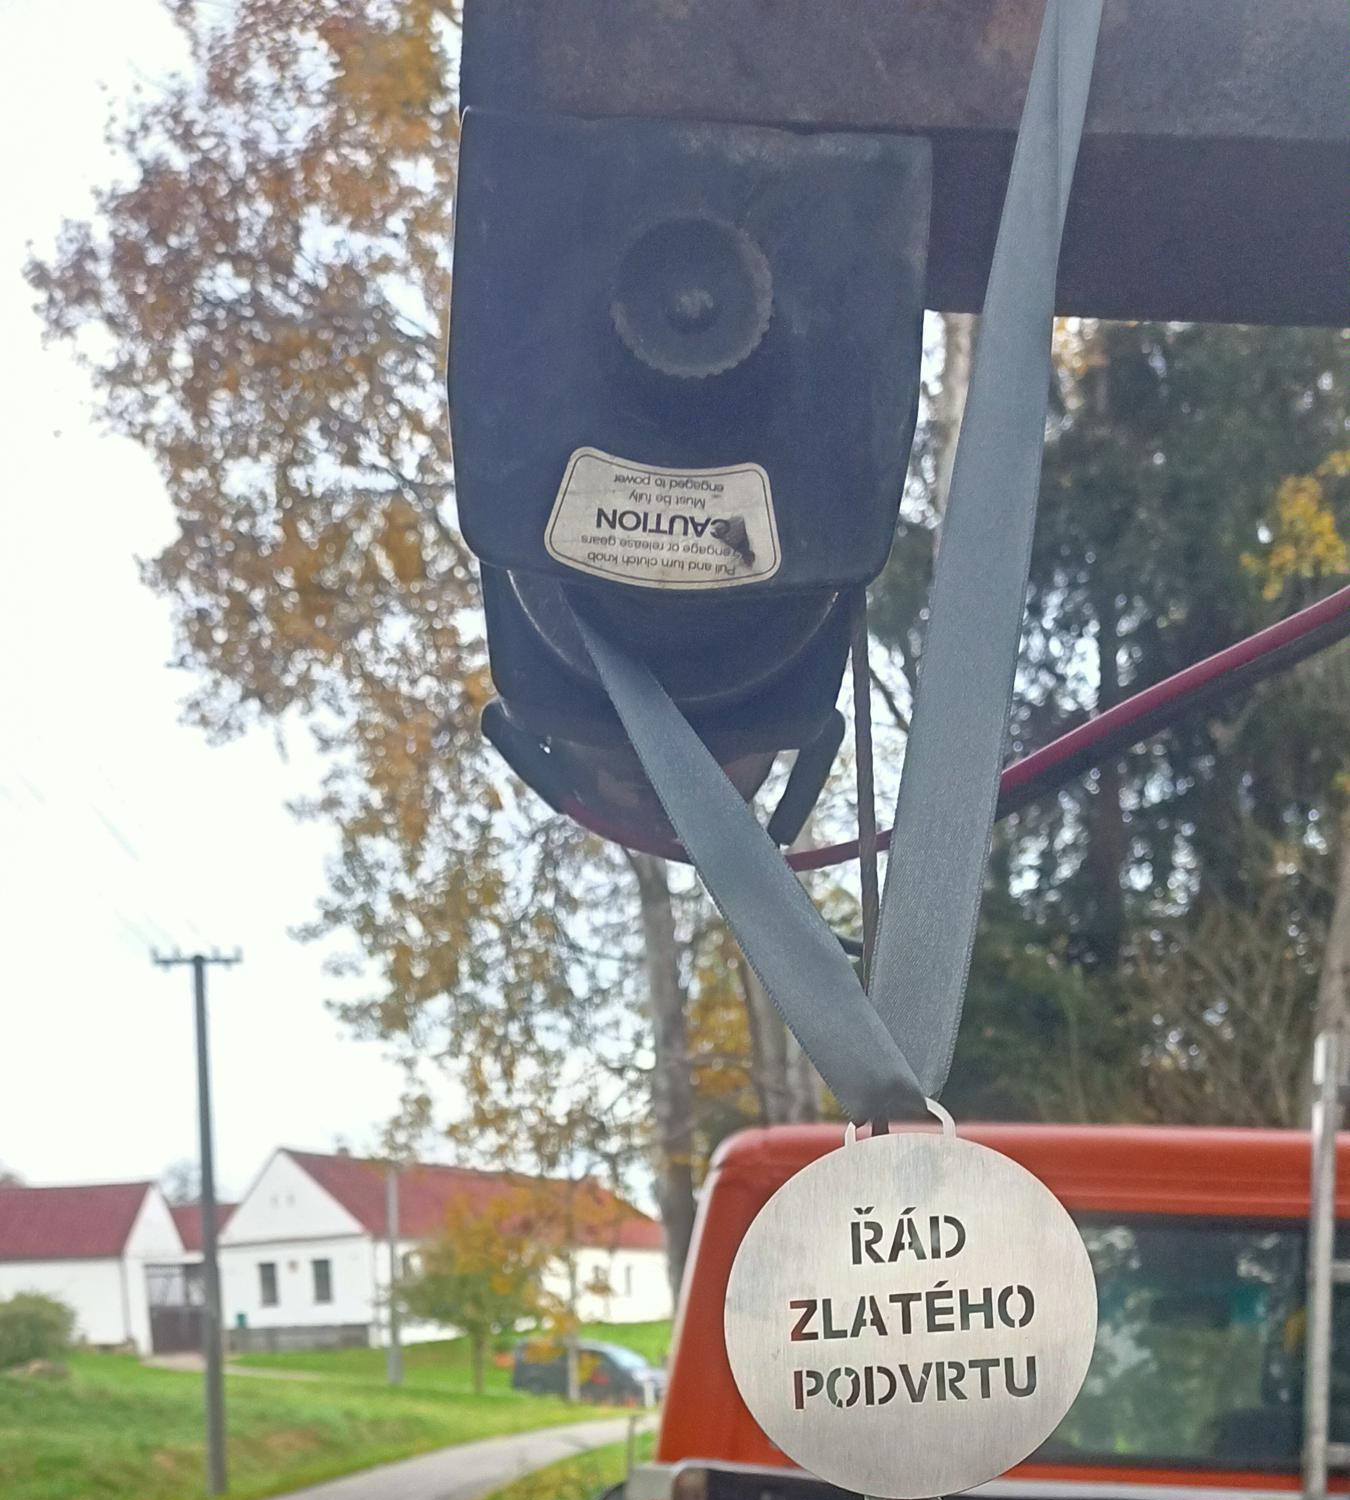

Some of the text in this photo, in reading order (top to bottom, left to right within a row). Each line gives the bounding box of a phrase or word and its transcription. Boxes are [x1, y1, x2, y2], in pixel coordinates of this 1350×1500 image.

[614, 473, 724, 492] engaged to power
[629, 489, 705, 509] Must be fully
[596, 508, 730, 538] CAUTION
[581, 535, 616, 547] gears
[620, 539, 664, 550] release
[666, 543, 679, 552] or
[683, 545, 730, 557] engage
[588, 551, 735, 576] Pull and turn clutch knob
[850, 1206, 966, 1265] ŘÁD
[789, 1280, 1035, 1342] ZLATÉHO
[793, 1356, 1037, 1410] PODVRTU
